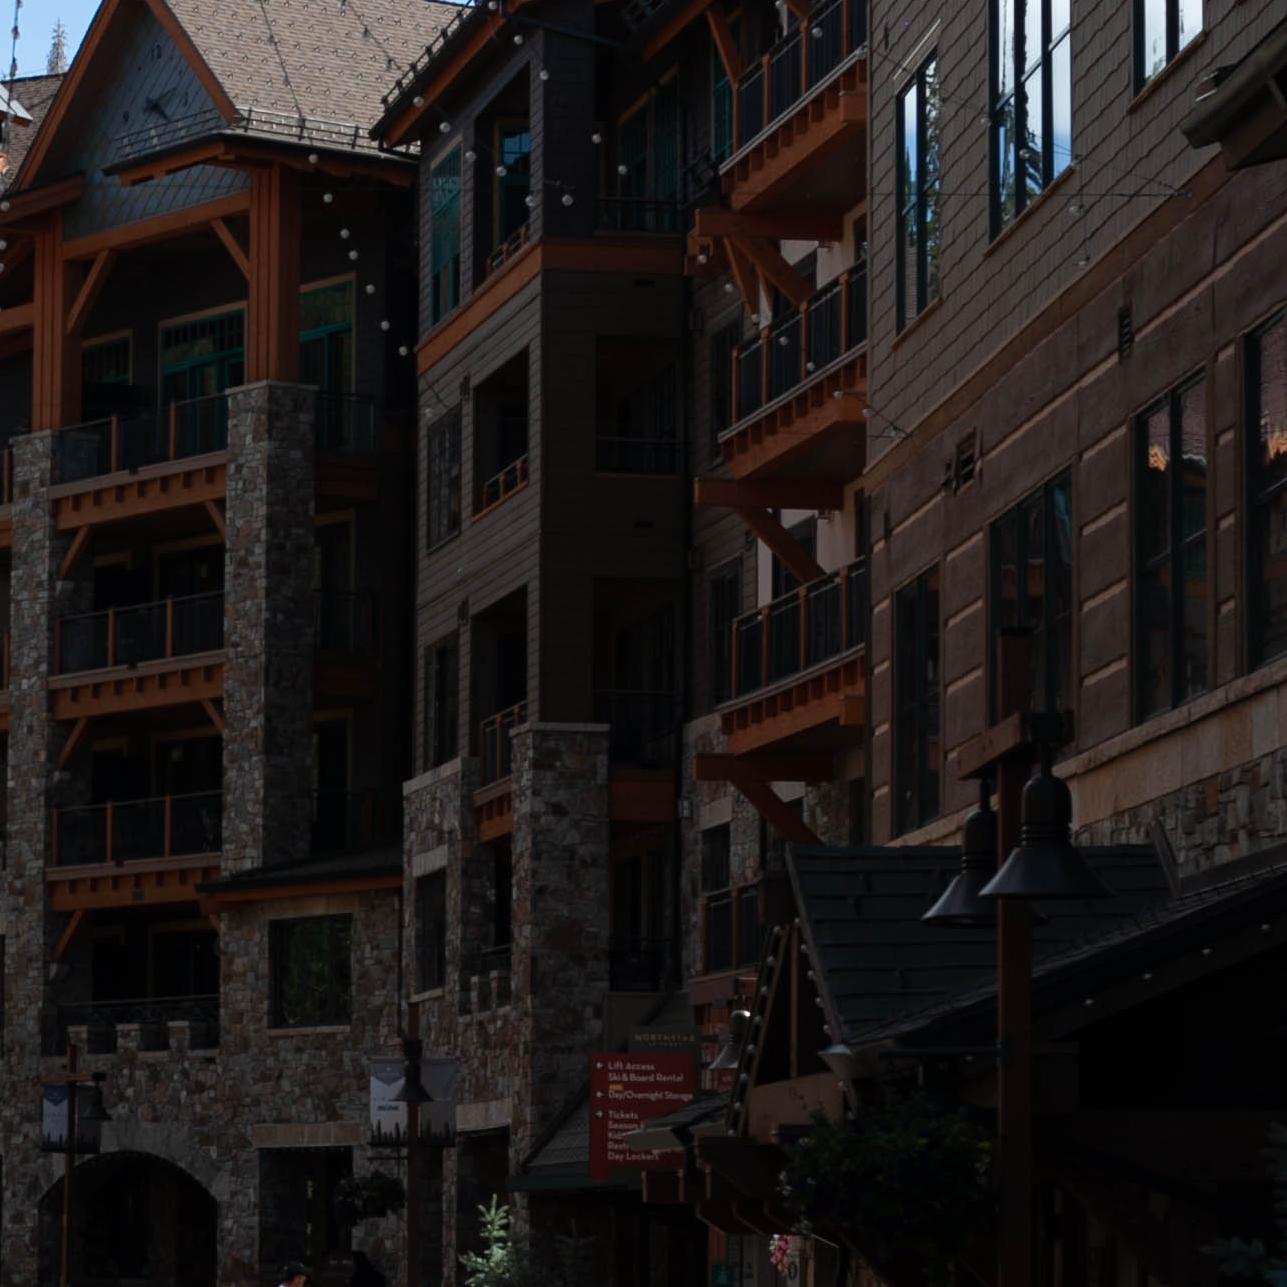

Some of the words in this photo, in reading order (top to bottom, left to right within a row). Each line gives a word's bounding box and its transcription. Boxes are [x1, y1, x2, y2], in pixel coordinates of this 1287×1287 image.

[633, 1033, 697, 1042] NORTHSTAR
[608, 1060, 624, 1071] Lift
[624, 1061, 656, 1071] Access
[608, 1072, 621, 1082] Ski
[629, 1072, 655, 1082] Board
[656, 1073, 684, 1082] Rental
[608, 1090, 663, 1102] Day/Overnight
[664, 1091, 695, 1102] Storage
[608, 1110, 639, 1120] Tickets
[608, 1121, 639, 1129] Season
[607, 1151, 625, 1162] Day
[625, 1152, 660, 1161] Lockers
